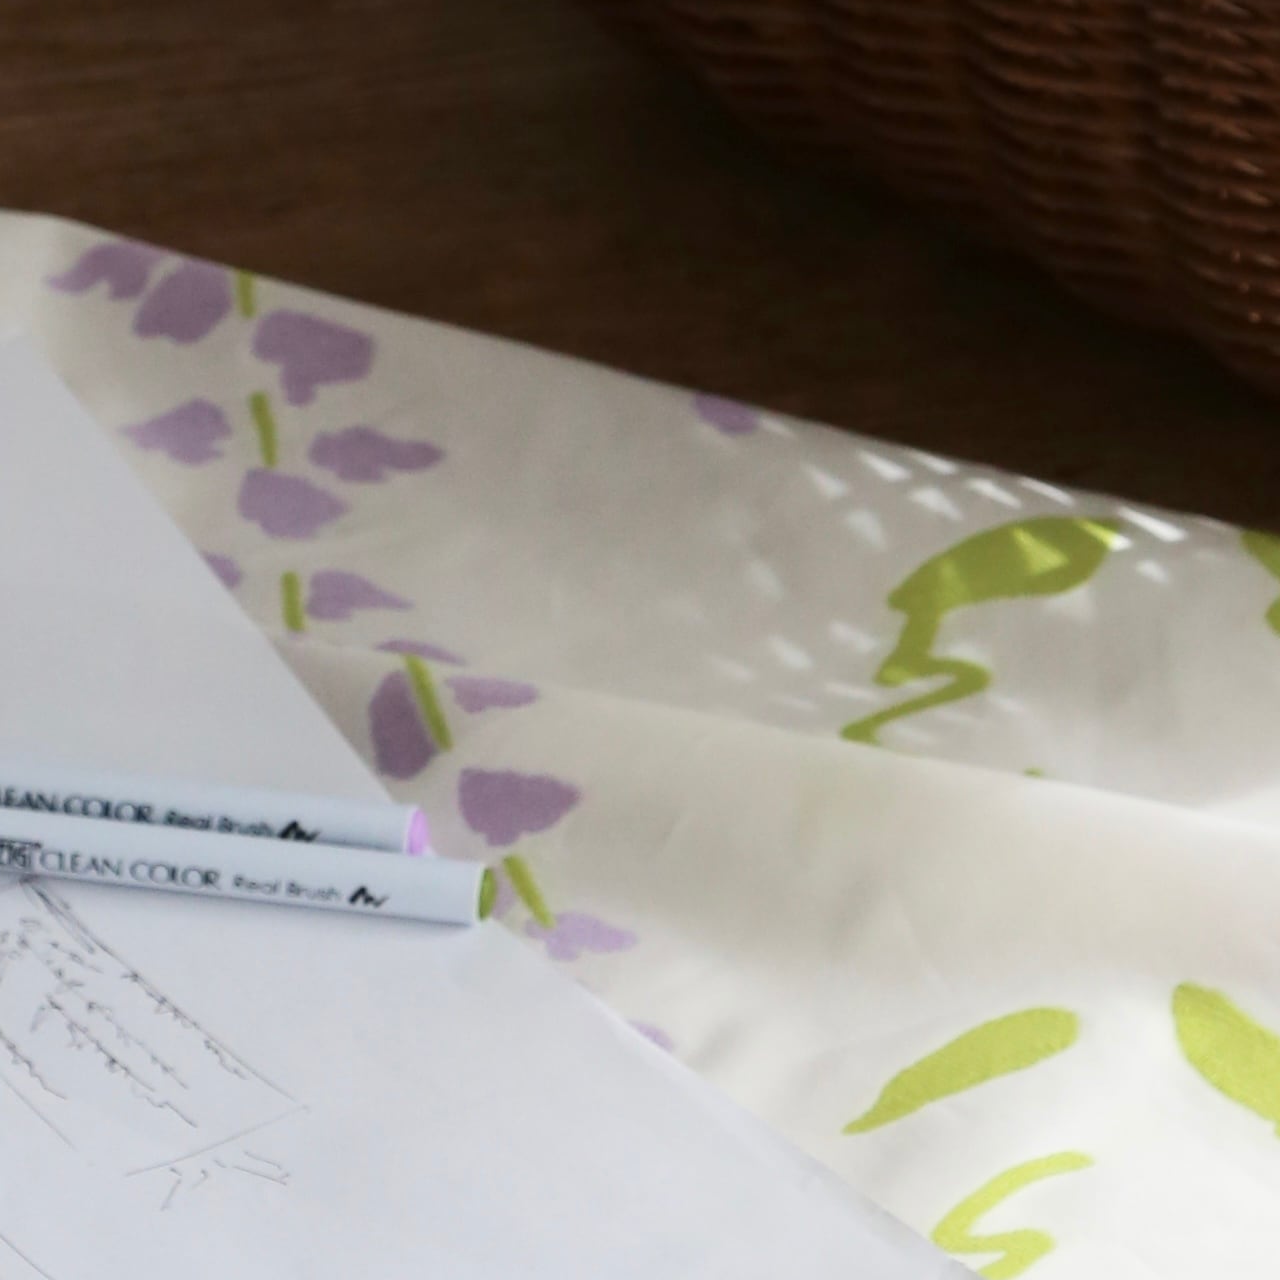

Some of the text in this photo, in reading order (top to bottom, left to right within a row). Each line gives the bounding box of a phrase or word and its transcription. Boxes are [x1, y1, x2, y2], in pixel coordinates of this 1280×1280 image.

[64, 797, 152, 823] COLOR
[40, 852, 121, 876] CLEAN
[130, 862, 220, 889] COLOR
[234, 874, 278, 893] Real
[286, 881, 342, 900] Brush
